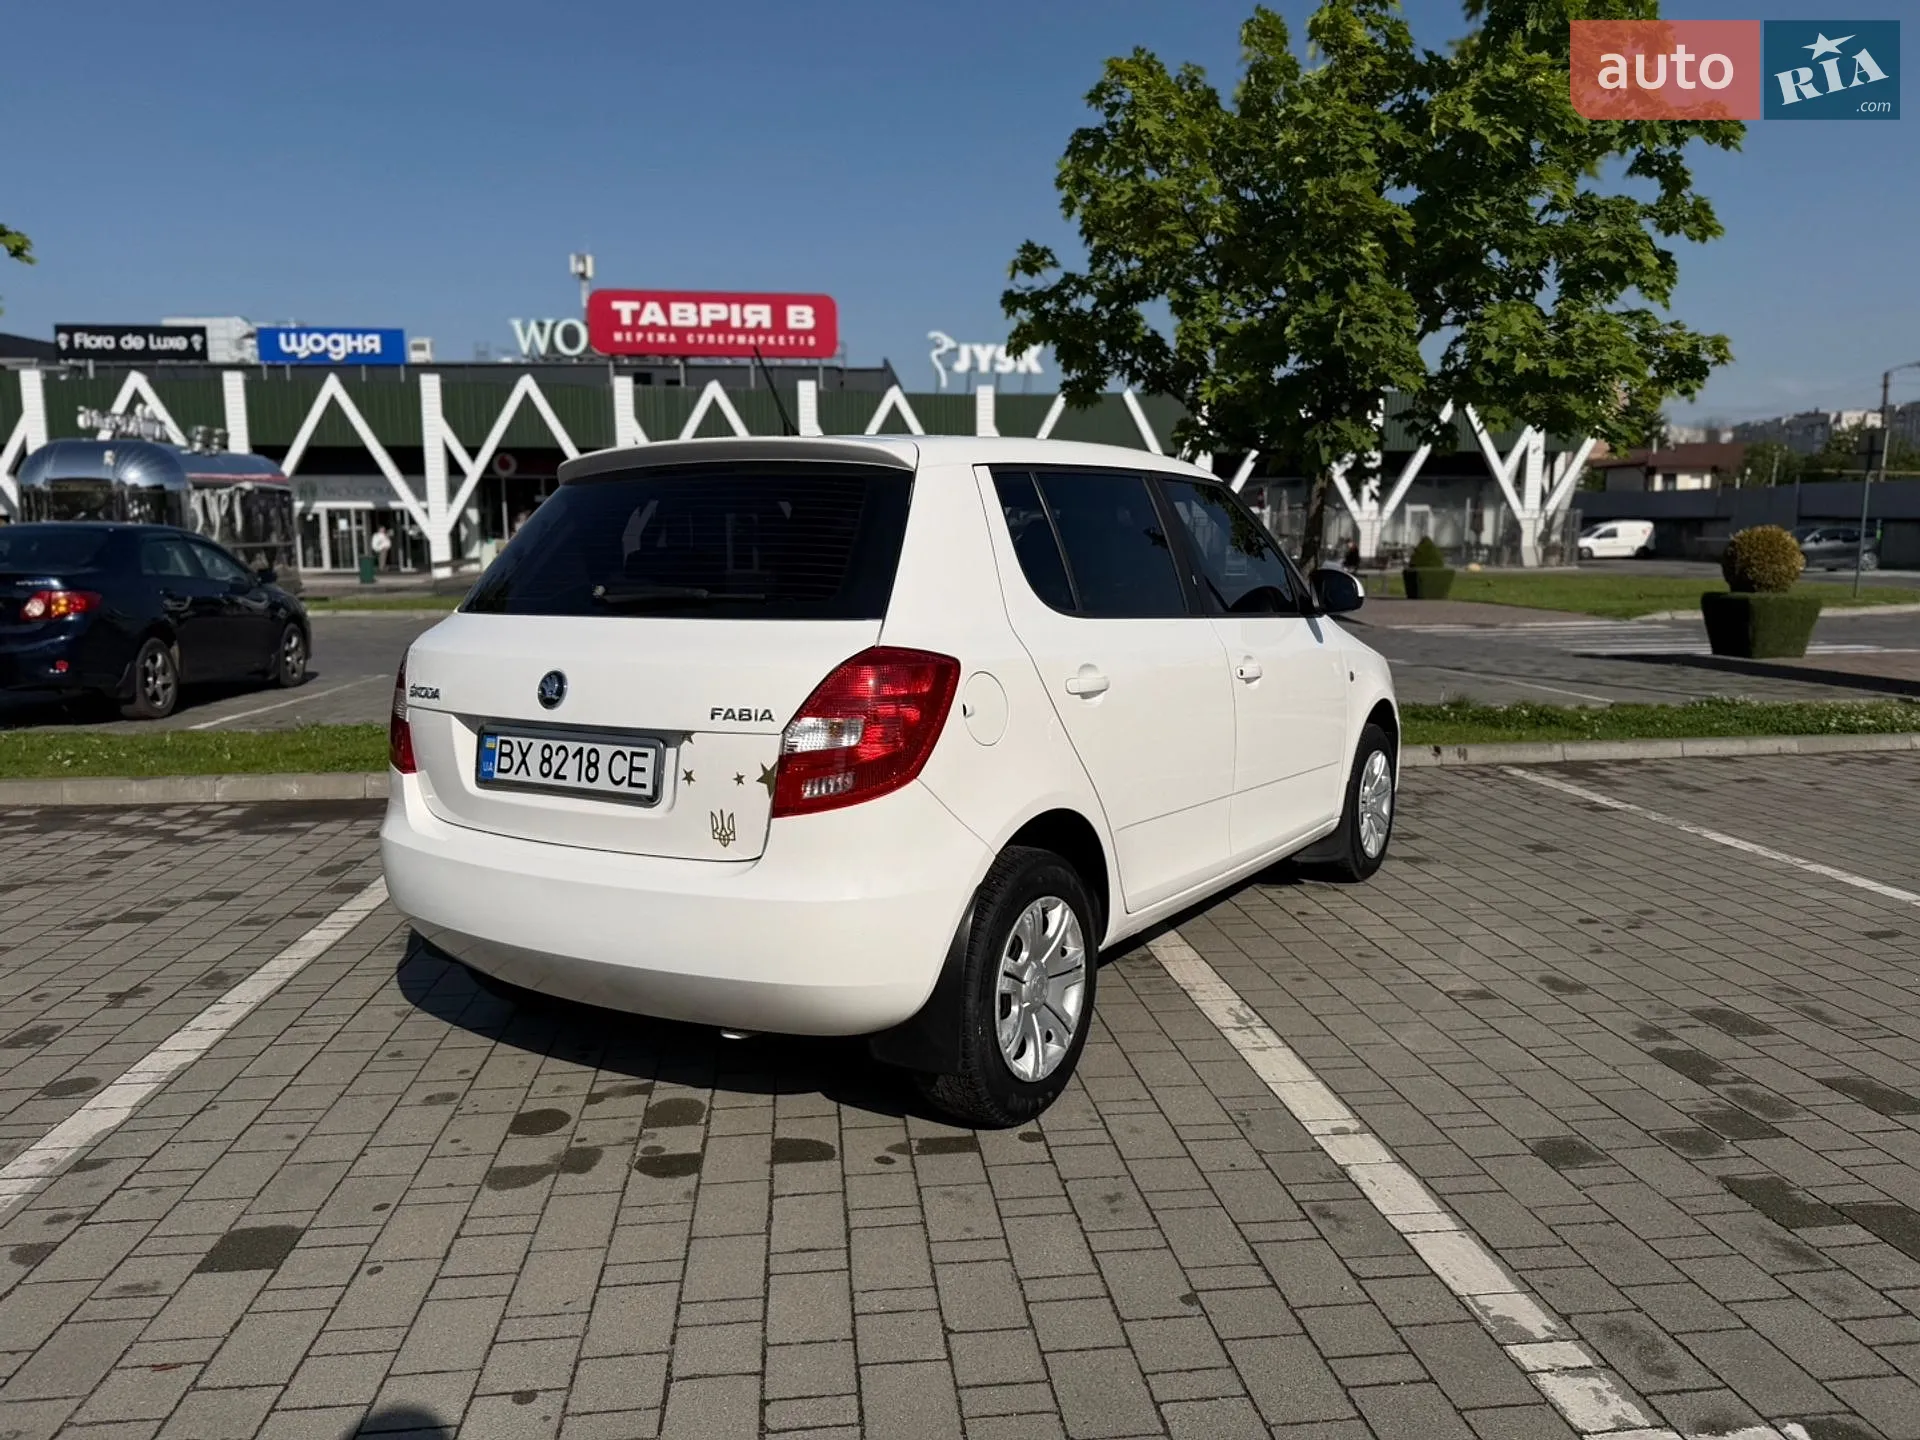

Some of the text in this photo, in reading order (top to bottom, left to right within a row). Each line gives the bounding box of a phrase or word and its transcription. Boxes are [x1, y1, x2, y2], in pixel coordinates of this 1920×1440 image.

[611, 300, 816, 329] ТАВРІЯ В
[73, 331, 189, 351] Flora de Luxe
[612, 331, 817, 347] МЕРЕЖА СУПЕРМАРКЕТІВ
[953, 342, 1044, 374] JYSK
[710, 707, 776, 723] FABIA
[496, 738, 649, 790] BX 8218 CE
